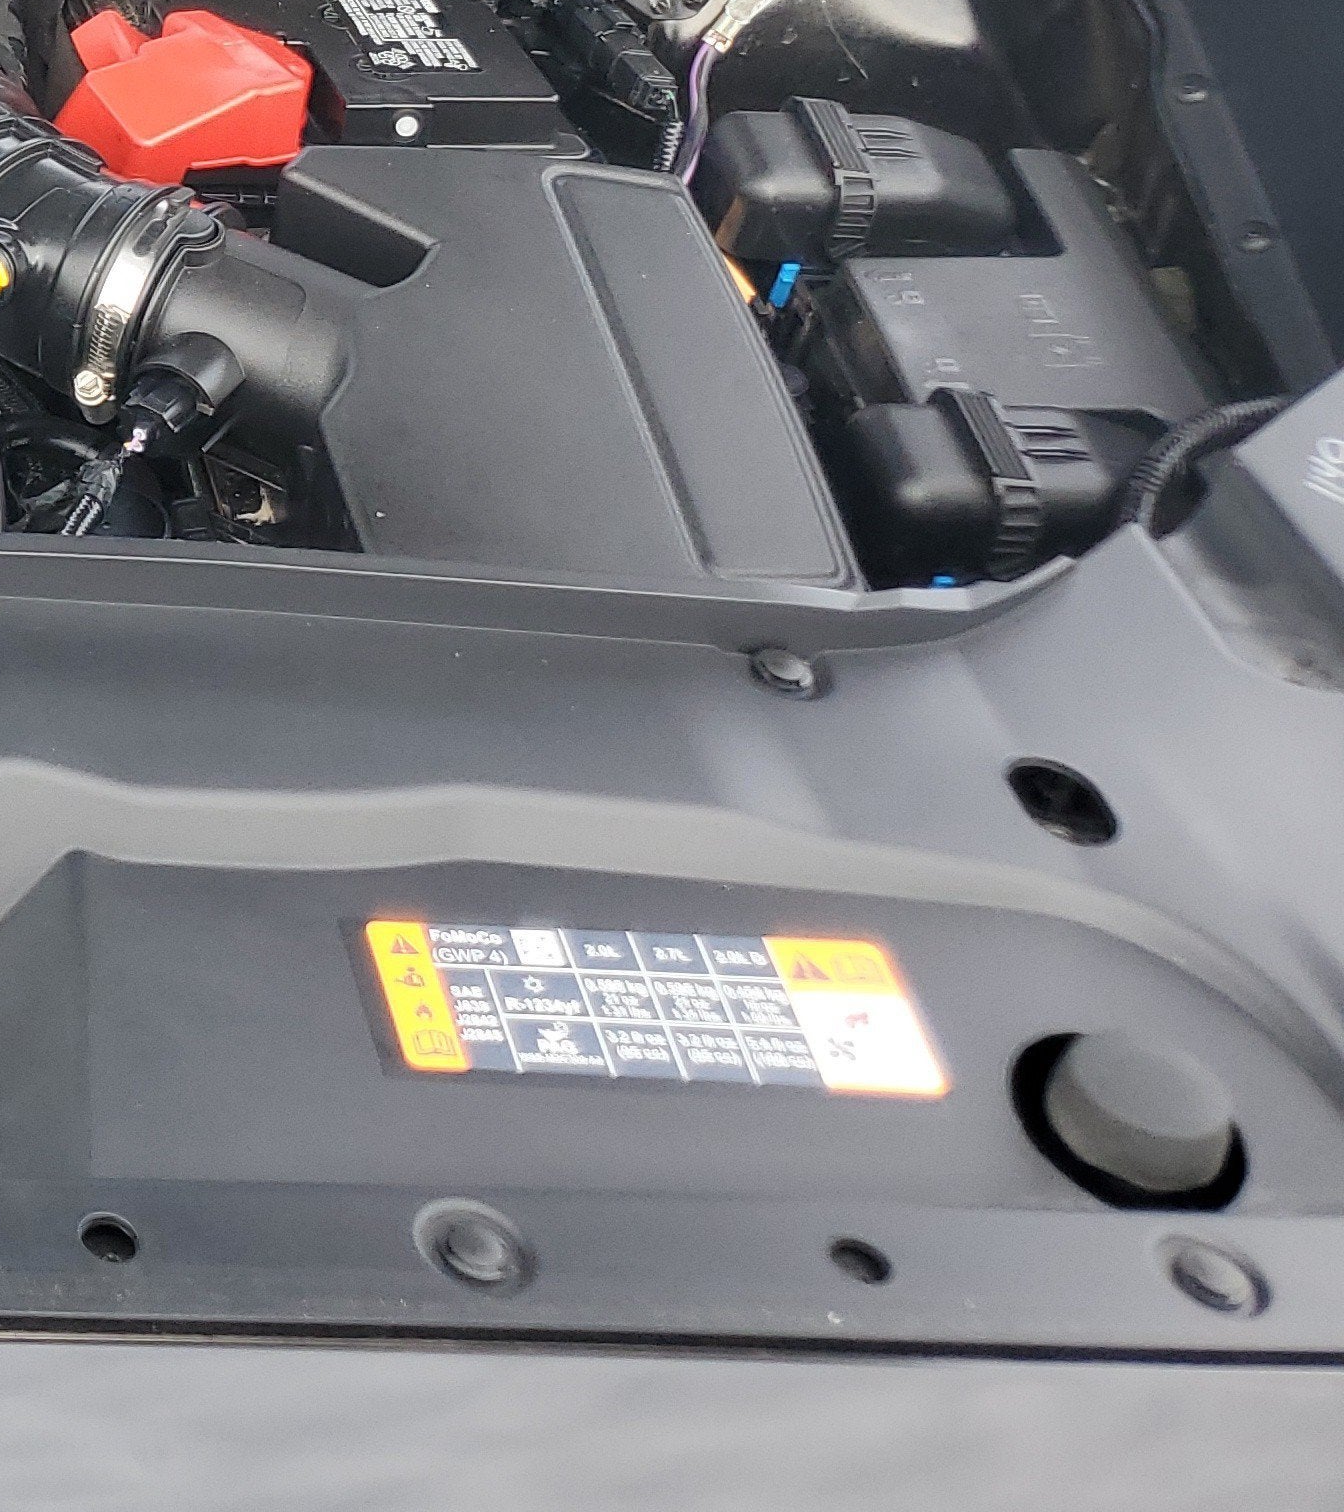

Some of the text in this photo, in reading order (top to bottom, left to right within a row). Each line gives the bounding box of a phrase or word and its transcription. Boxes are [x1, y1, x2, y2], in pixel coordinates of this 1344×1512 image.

[428, 928, 503, 945] FoMoCo
[432, 947, 509, 965] (GWP 4)
